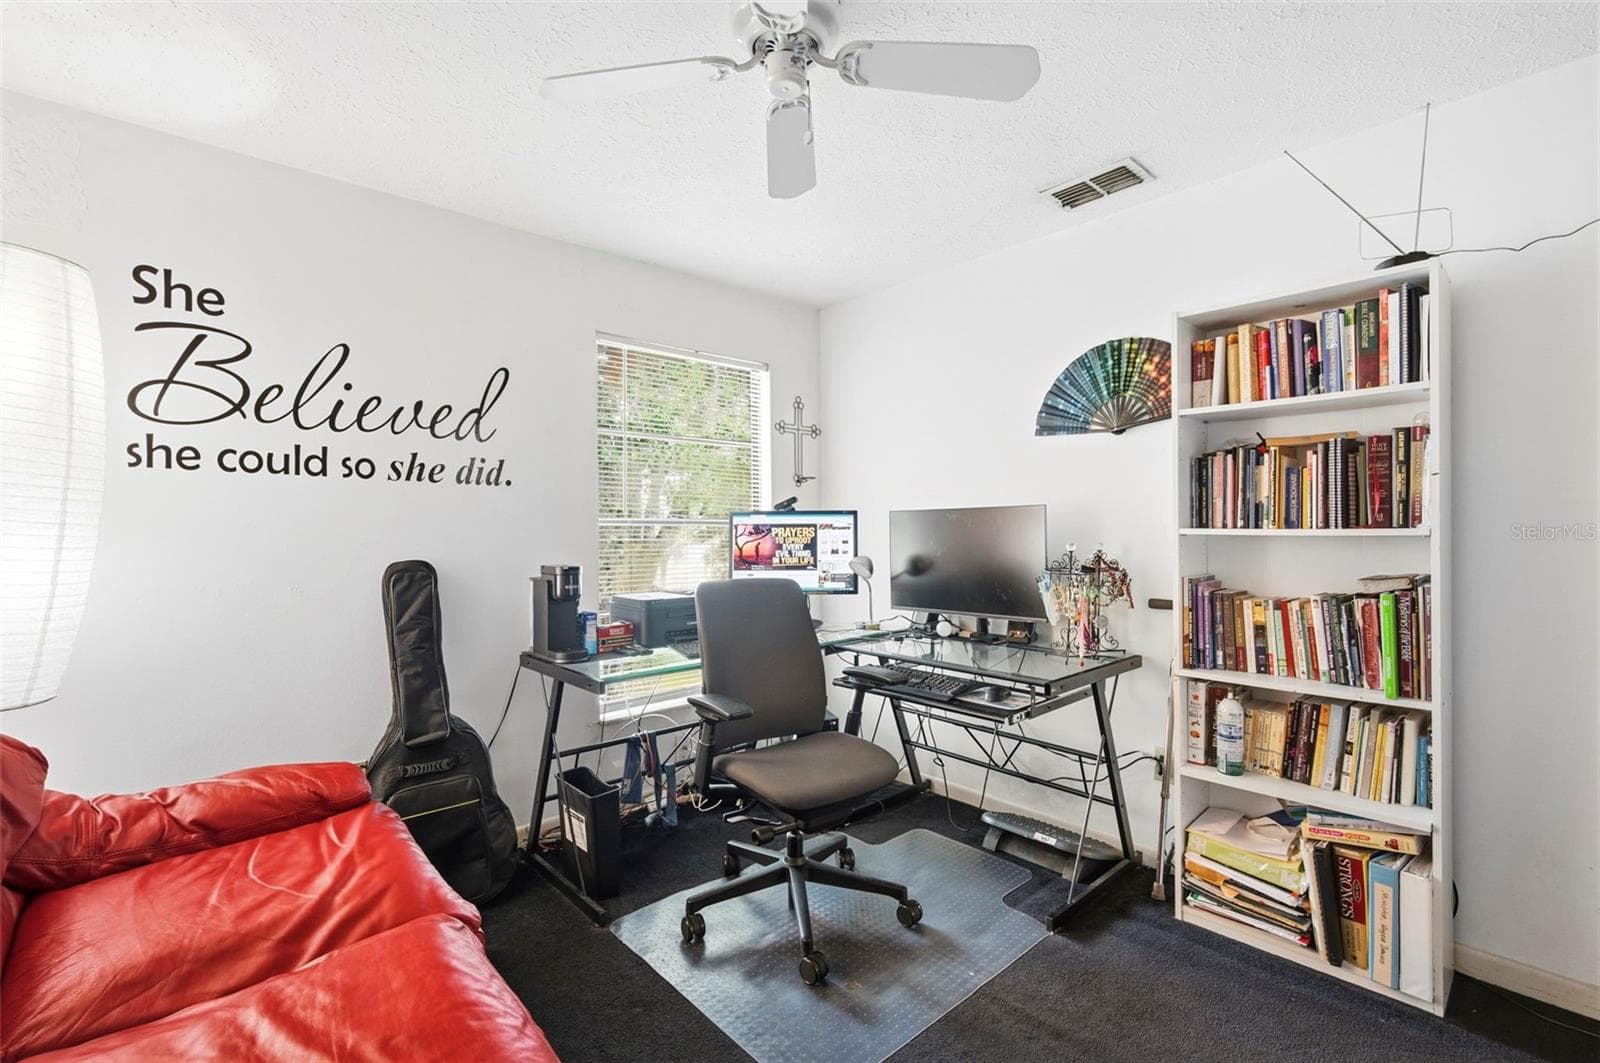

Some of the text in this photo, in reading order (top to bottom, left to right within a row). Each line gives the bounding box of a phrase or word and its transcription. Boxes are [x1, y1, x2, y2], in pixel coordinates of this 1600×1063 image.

[132, 264, 225, 317] She
[127, 321, 510, 443] Believed
[126, 433, 512, 488] she could so she did.
[771, 527, 815, 537] PRAYERS
[1398, 596, 1411, 628] Mysteries
